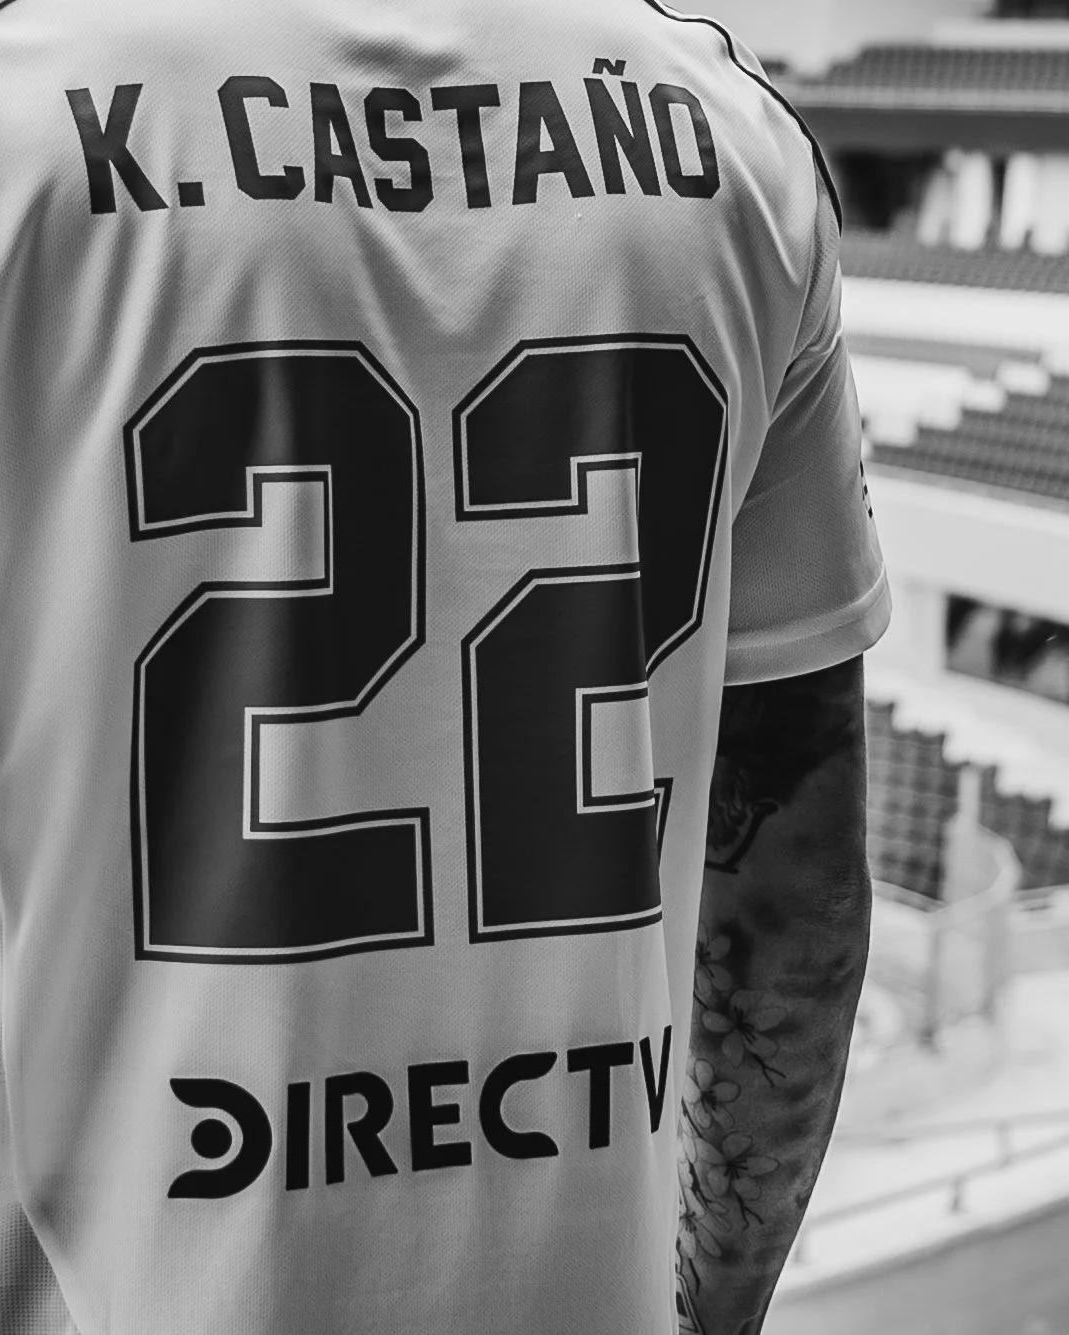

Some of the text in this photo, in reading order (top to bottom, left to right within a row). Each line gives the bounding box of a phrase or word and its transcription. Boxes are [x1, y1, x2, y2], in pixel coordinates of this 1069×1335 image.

[65, 58, 721, 213] K. CASTAÑO
[123, 334, 729, 964] 22
[167, 1025, 672, 1199] DIRECTV
